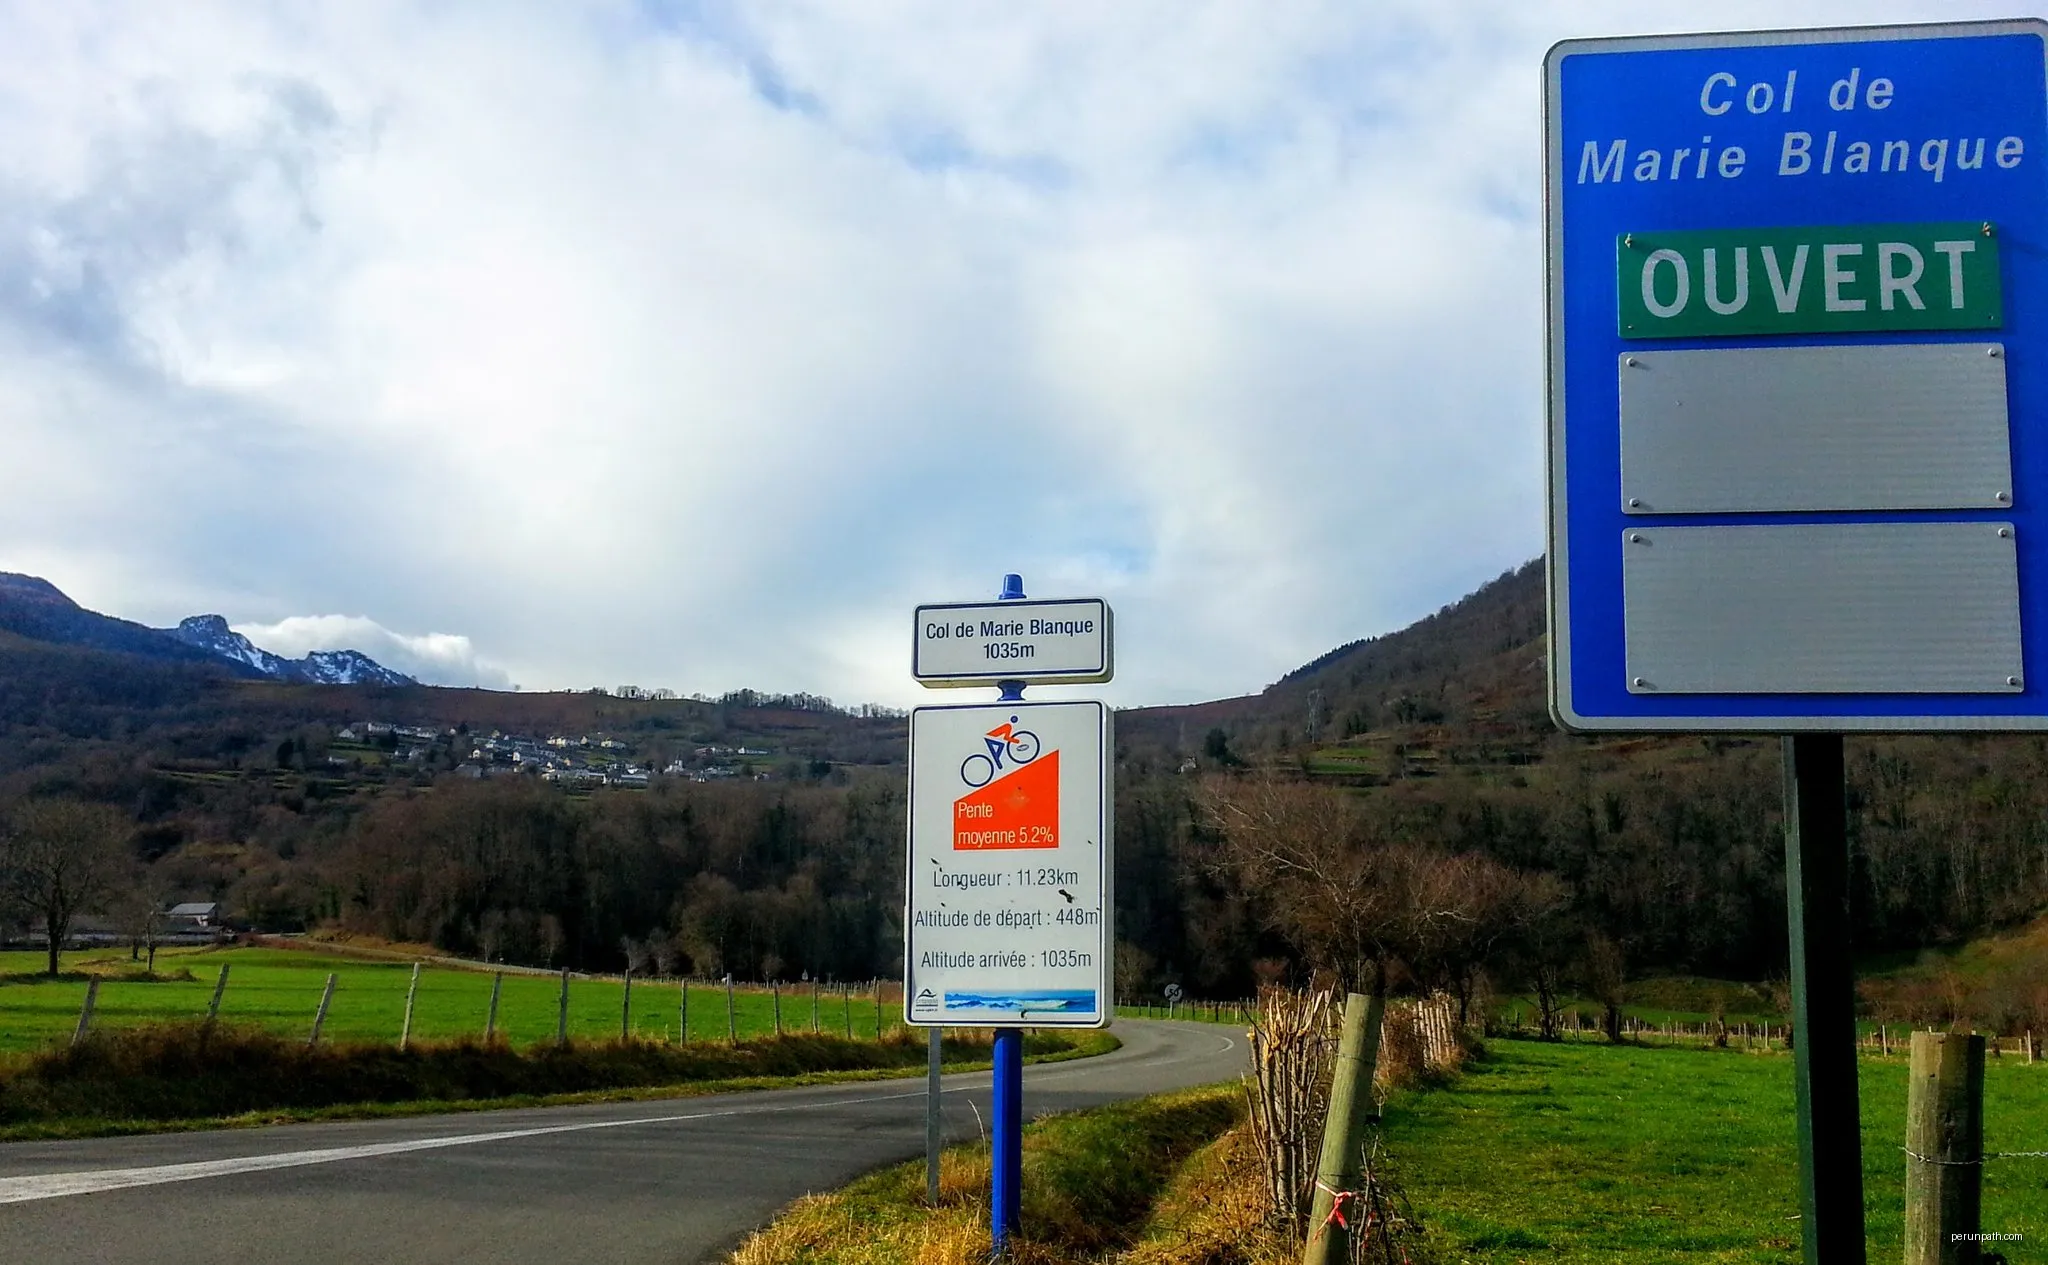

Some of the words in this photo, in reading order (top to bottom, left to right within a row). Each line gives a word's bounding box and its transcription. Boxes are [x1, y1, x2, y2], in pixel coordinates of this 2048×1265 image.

[1700, 70, 1797, 116] Col
[1828, 67, 1894, 111] de
[1577, 136, 1746, 184] Marie
[1779, 131, 2025, 183] Blanque
[1641, 240, 1976, 318] OUVERT
[926, 622, 949, 639] Col
[955, 622, 974, 637] de
[980, 620, 1024, 637] Marie
[1030, 619, 1093, 637] Blanque
[983, 642, 1035, 659] 1035m
[957, 802, 993, 819] Pente
[957, 830, 1016, 848] moyenne
[1019, 826, 1054, 843] 5.2%
[933, 871, 1002, 890] Longueur
[1017, 868, 1078, 886] 11.23km
[915, 910, 968, 927] Altitude
[974, 909, 991, 926] de
[996, 908, 1042, 929] départ
[1056, 908, 1098, 926] 448m
[921, 951, 975, 968] Altitude
[979, 950, 1026, 968] arrivée
[1041, 950, 1091, 967] 1035m
